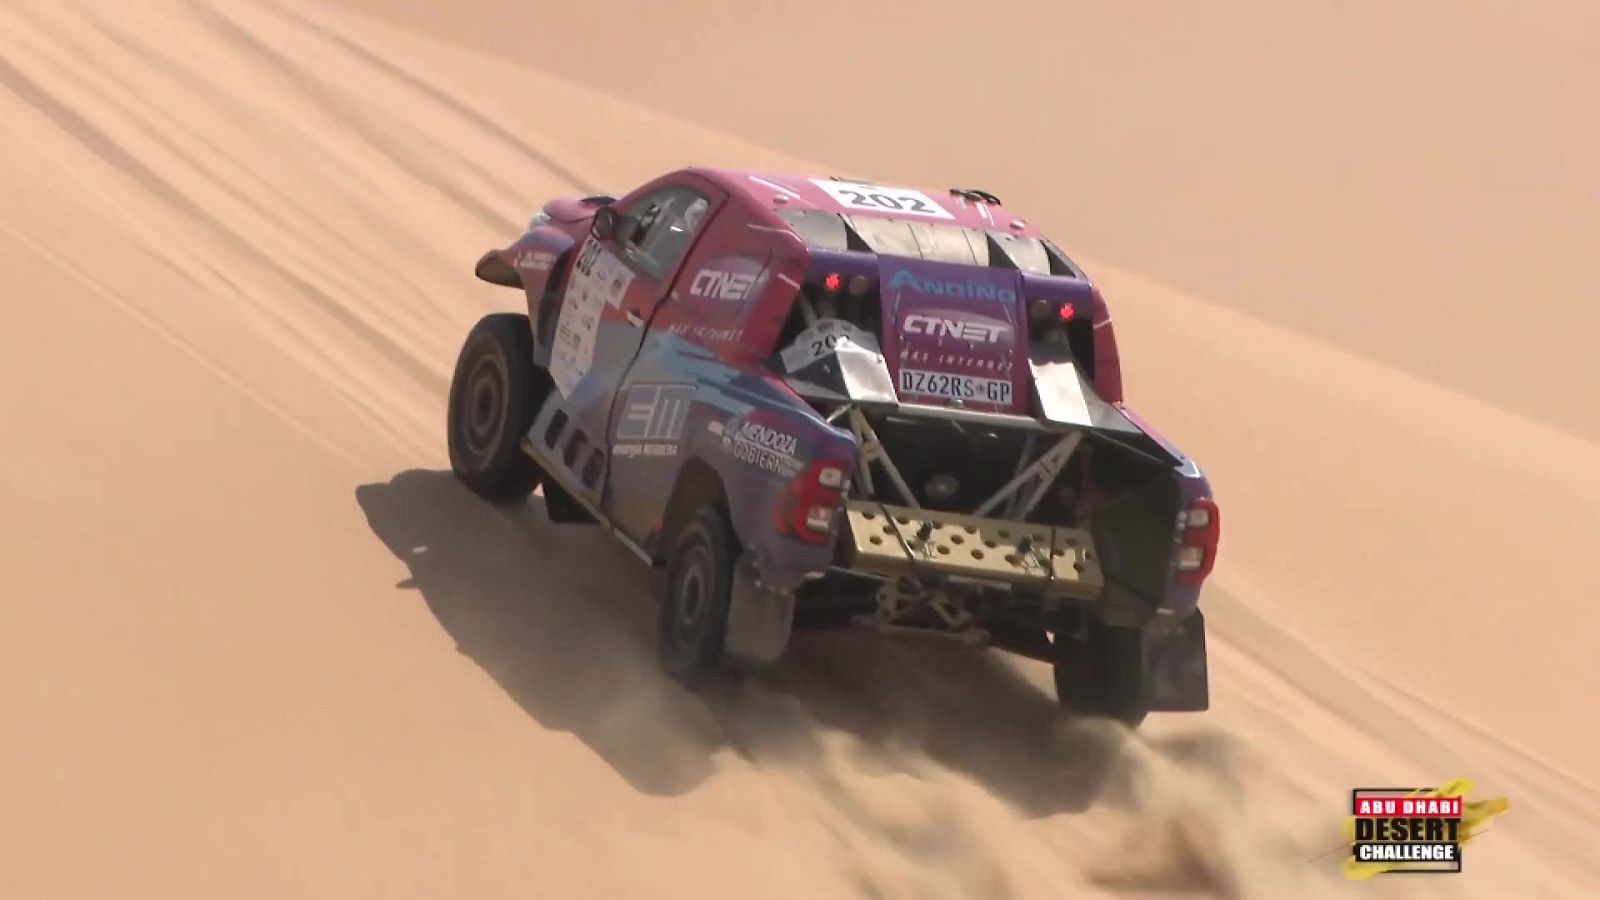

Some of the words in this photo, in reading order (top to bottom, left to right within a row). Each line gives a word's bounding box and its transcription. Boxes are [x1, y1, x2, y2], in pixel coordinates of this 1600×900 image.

[838, 189, 936, 214] 202
[903, 315, 1008, 343] CTNET
[902, 371, 974, 398] DZ62RS
[987, 381, 1009, 402] GP
[740, 421, 798, 456] MENDOZA
